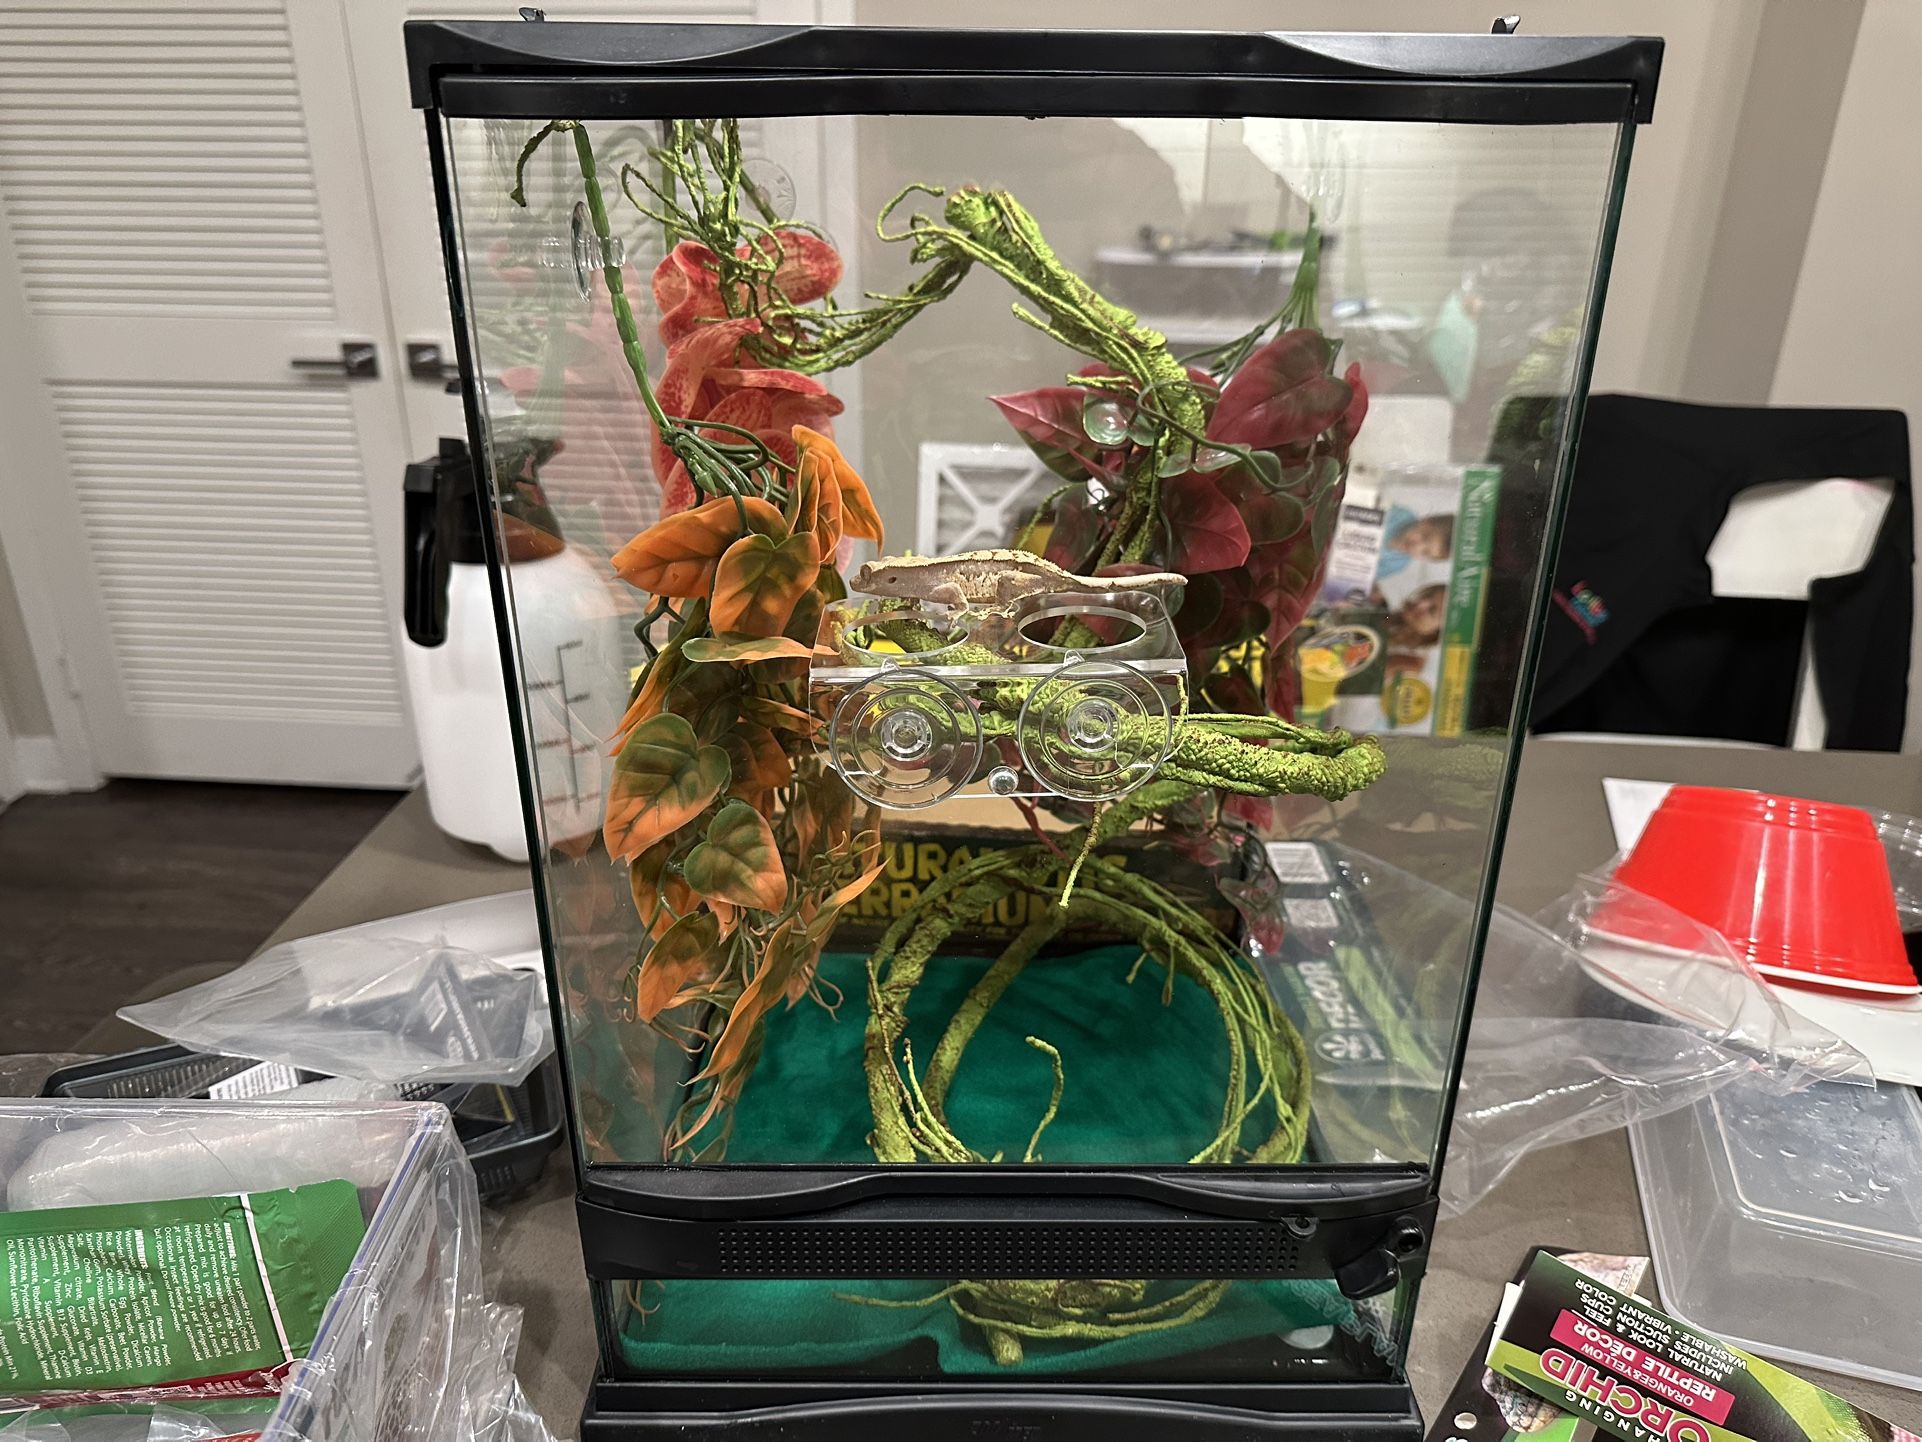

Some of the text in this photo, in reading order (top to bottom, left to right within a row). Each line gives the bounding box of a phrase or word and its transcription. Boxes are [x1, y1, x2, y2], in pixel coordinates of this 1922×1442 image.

[105, 1231, 113, 1246] Rice
[153, 1227, 162, 1239] but
[193, 1223, 205, 1252] Prepared
[203, 1223, 212, 1238] daily
[212, 1222, 223, 1242] adjust
[85, 1232, 97, 1258] Xanthan
[164, 1226, 175, 1262] Occasional
[183, 1224, 196, 1264] refrigerated.
[207, 1239, 216, 1252] and
[83, 1257, 92, 1283] Choline
[200, 1255, 208, 1268] mix
[210, 1253, 219, 1277] remove
[219, 1249, 228, 1274] achieve
[230, 1259, 238, 1271] Mix
[115, 1268, 125, 1290] Whole
[160, 1269, 169, 1279] Do
[169, 1265, 179, 1283] insect
[189, 1264, 199, 1282] Open
[232, 1276, 242, 1289] part
[53, 1278, 62, 1305] Vitamin
[96, 1276, 106, 1310] Potassium
[164, 1279, 172, 1290] not
[193, 1283, 202, 1294] dry
[202, 1281, 213, 1298] good
[214, 1279, 225, 1303] uneaten
[223, 1274, 234, 1296] desired
[1573, 1278, 1618, 1306] COLOR
[8, 1250, 17, 1287] Sunflower
[14, 1317, 24, 1331] Folic
[19, 1332, 29, 1344] Acid
[36, 1236, 47, 1260] Vitamin
[57, 1349, 72, 1377] D-Calcium
[66, 1233, 80, 1270] Magnesium
[77, 1305, 88, 1322] Dried
[88, 1343, 100, 1365] Vitamin
[105, 1267, 114, 1295] Calcium
[117, 1331, 126, 1345] Beet
[117, 1296, 127, 1308] Egg
[124, 1229, 138, 1267] Watermelon
[140, 1295, 152, 1317] Apricot
[152, 1345, 162, 1366] Mango
[150, 1288, 160, 1306] Blend
[167, 1290, 177, 1308] freeze
[173, 1285, 185, 1311] feedings
[177, 1255, 191, 1294] temperature
[188, 1310, 198, 1322] year
[195, 1328, 212, 1359] refrigerated.
[196, 1294, 205, 1305] mix
[208, 1300, 216, 1308] for
[236, 1289, 249, 1309] powder
[56, 1308, 65, 1320] B12
[169, 1308, 181, 1332] powder.
[199, 1311, 212, 1325] good
[211, 1311, 218, 1319] up
[220, 1303, 230, 1315] food
[1619, 1301, 1674, 1334] VIBRANT
[19, 1283, 31, 1319] Pyridoxine
[39, 1360, 52, 1380] Mineral
[32, 1285, 42, 1318] Riboflavin
[49, 1354, 62, 1379] Thiamine
[64, 1282, 72, 1298] Zinc
[77, 1340, 88, 1361] Vitamin
[84, 1366, 93, 1374] D3
[100, 1310, 112, 1332] Sorbate
[154, 1315, 165, 1339] (Banana
[206, 1325, 214, 1333] for
[224, 1316, 234, 1329] after
[238, 1326, 248, 1338] Offer
[245, 1320, 257, 1334] parts
[137, 1322, 148, 1344] Micellar
[184, 1324, 202, 1361] recommended
[219, 1336, 229, 1349] days
[1578, 1291, 1734, 1375] INCLUDES SUCTION CUPS
[1581, 1304, 1722, 1381] NATURAL LOOK & FEEL
[130, 1339, 143, 1367] Dicalcium
[210, 1338, 222, 1357] months
[243, 1338, 253, 1351] food
[1680, 1330, 1748, 1370] WASHABLE
[1572, 1320, 1716, 1401] REPTILE DÉCOR
[1579, 1342, 1695, 1406] ORANGE&YELLOW
[1539, 1347, 1711, 1442] ORCHID
[1564, 1390, 1663, 1442] HANGING
